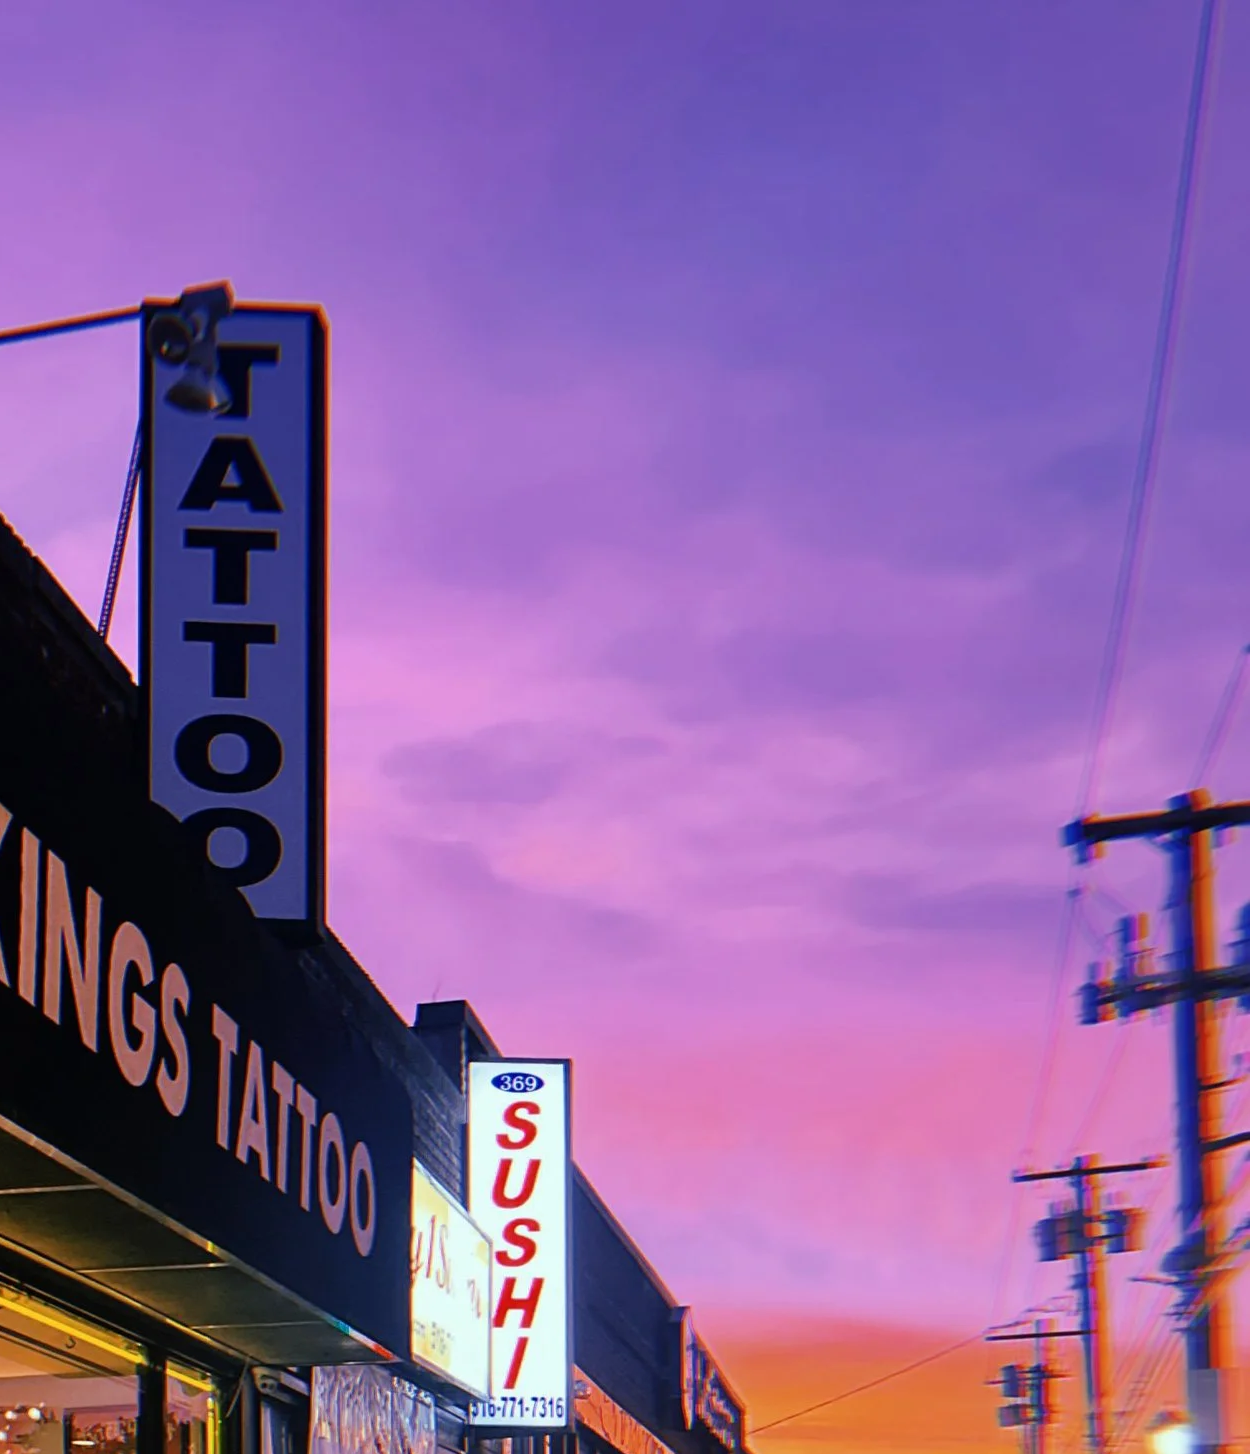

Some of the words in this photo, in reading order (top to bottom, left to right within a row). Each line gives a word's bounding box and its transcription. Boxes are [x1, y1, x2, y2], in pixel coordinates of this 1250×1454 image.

[173, 342, 285, 892] TATTOO
[212, 1003, 376, 1258] TATTOO
[500, 1075, 537, 1092] 369
[491, 1100, 545, 1390] SUSHI
